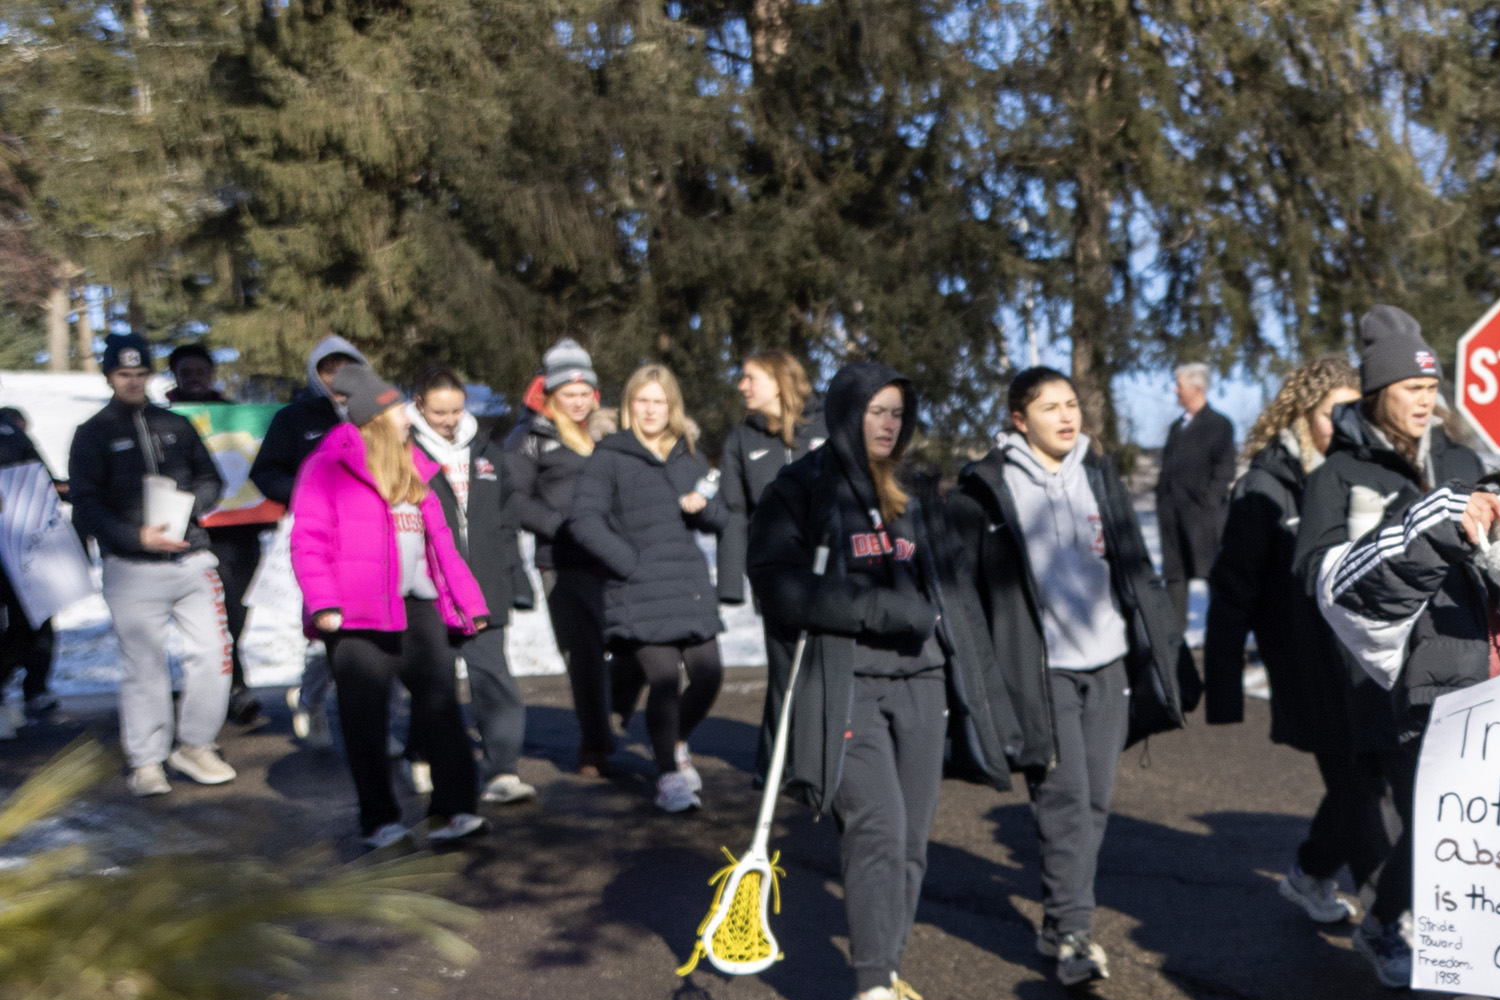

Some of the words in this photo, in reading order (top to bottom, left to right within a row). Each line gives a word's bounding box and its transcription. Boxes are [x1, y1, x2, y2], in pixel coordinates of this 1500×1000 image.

[1434, 883, 1458, 912] is
[1418, 916, 1457, 933] Stride
[1419, 933, 1463, 950] Toward
[1435, 970, 1461, 985] 1958
